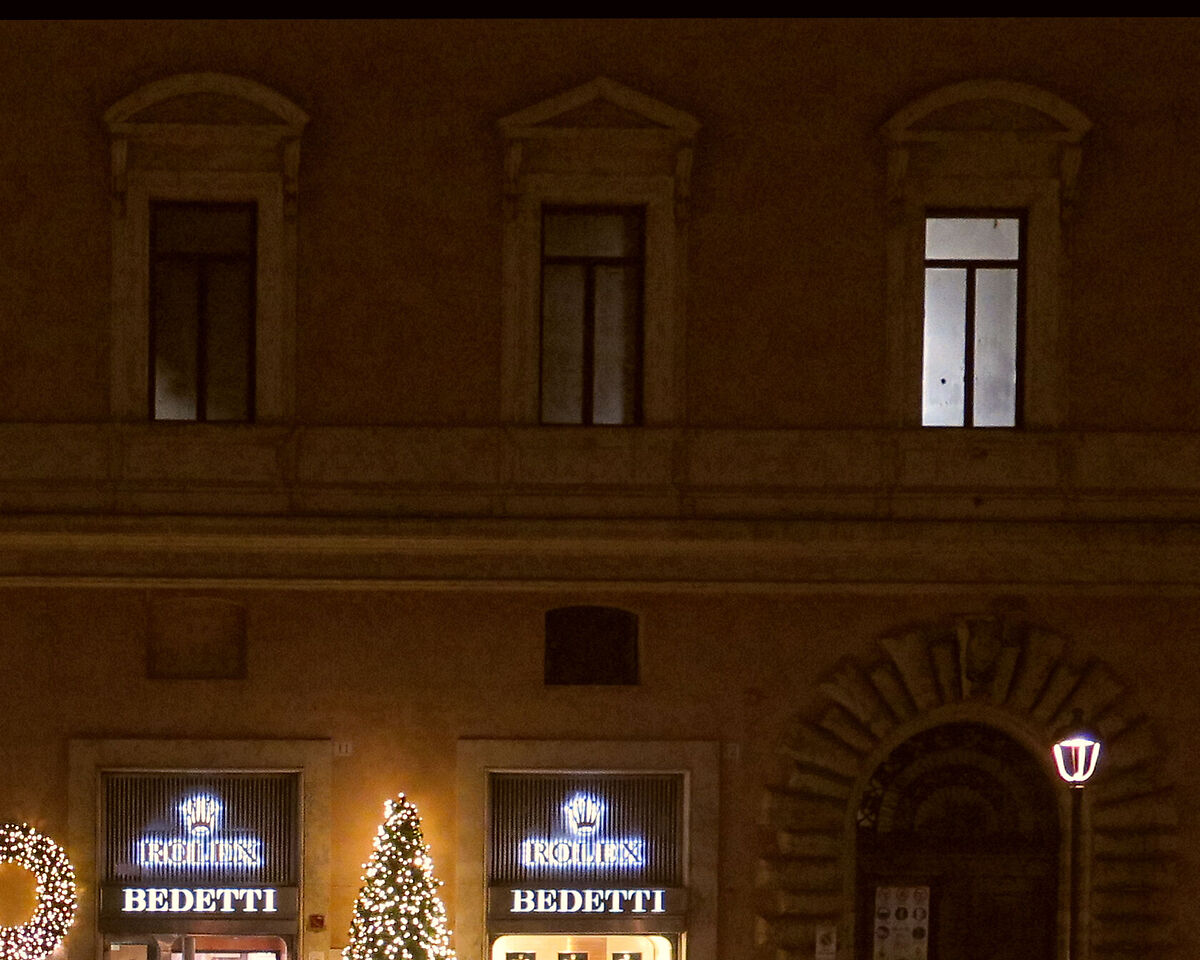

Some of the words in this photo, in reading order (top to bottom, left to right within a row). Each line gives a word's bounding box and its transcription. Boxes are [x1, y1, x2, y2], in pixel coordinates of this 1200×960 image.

[140, 839, 261, 866] ROLEX
[525, 839, 643, 866] ROLEX
[121, 888, 277, 912] BEDETTI
[510, 889, 666, 913] BEDETTI
